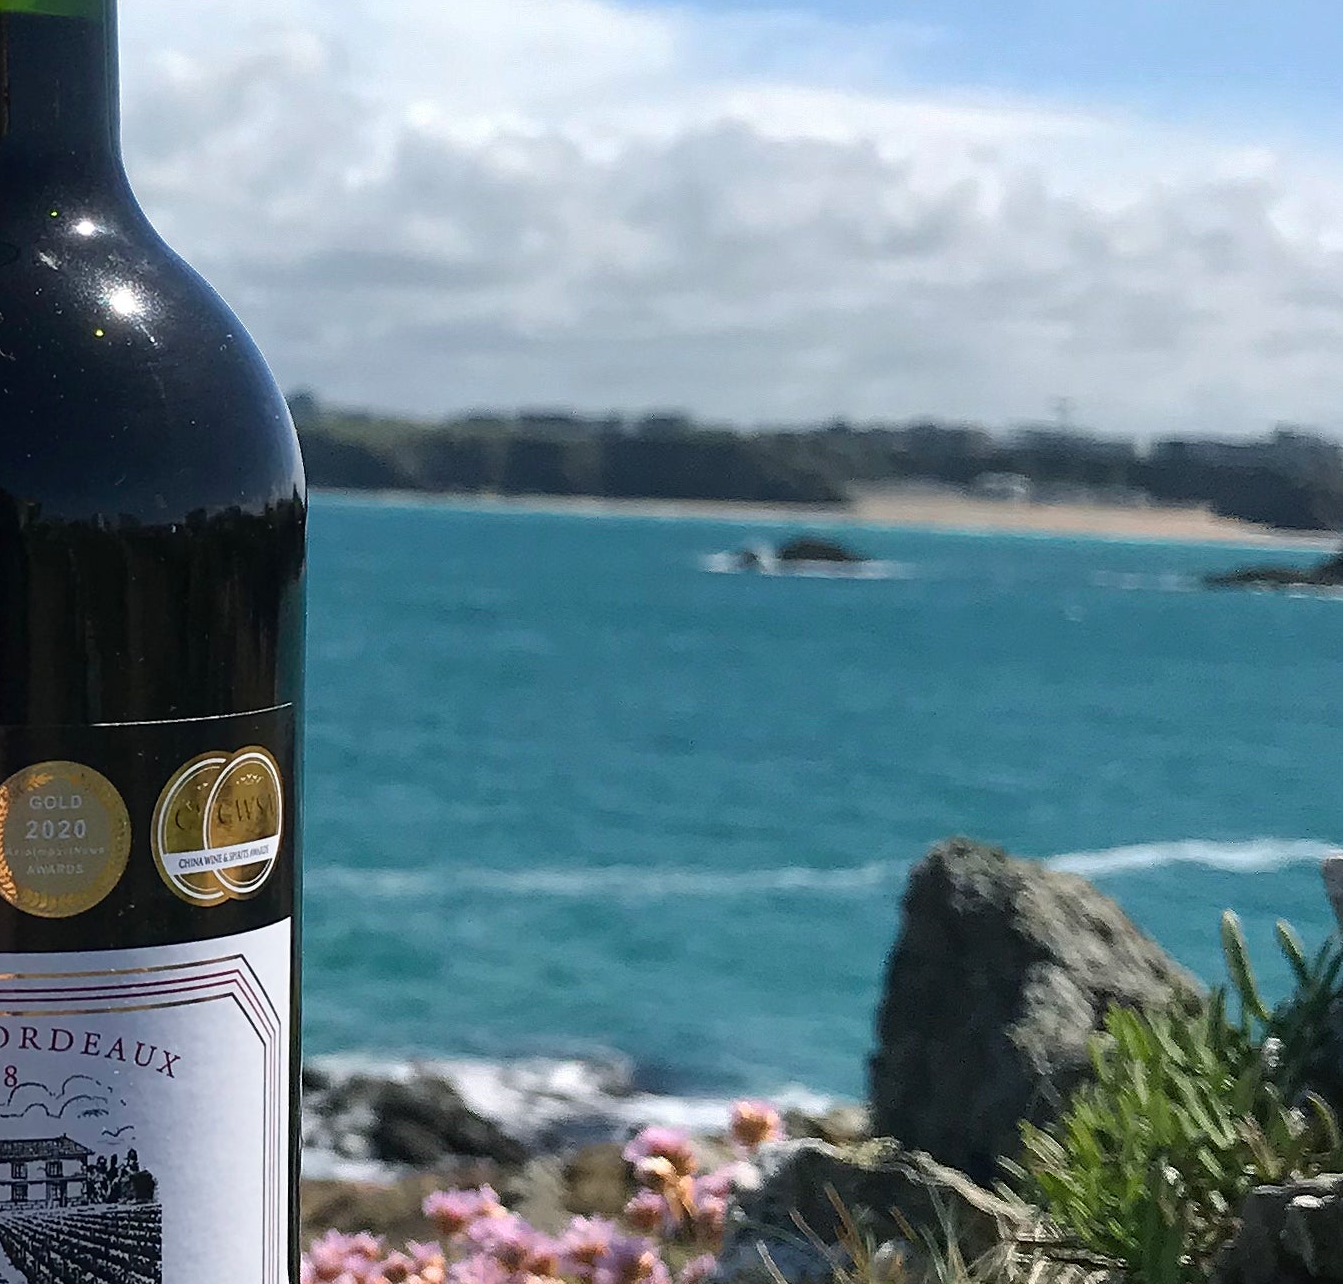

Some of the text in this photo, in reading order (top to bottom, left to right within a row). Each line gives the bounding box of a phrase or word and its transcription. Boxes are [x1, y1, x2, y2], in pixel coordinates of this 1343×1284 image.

[29, 794, 83, 810] GOLD
[25, 819, 87, 840] 2020
[178, 858, 204, 869] CHINA
[204, 854, 223, 865] WINE
